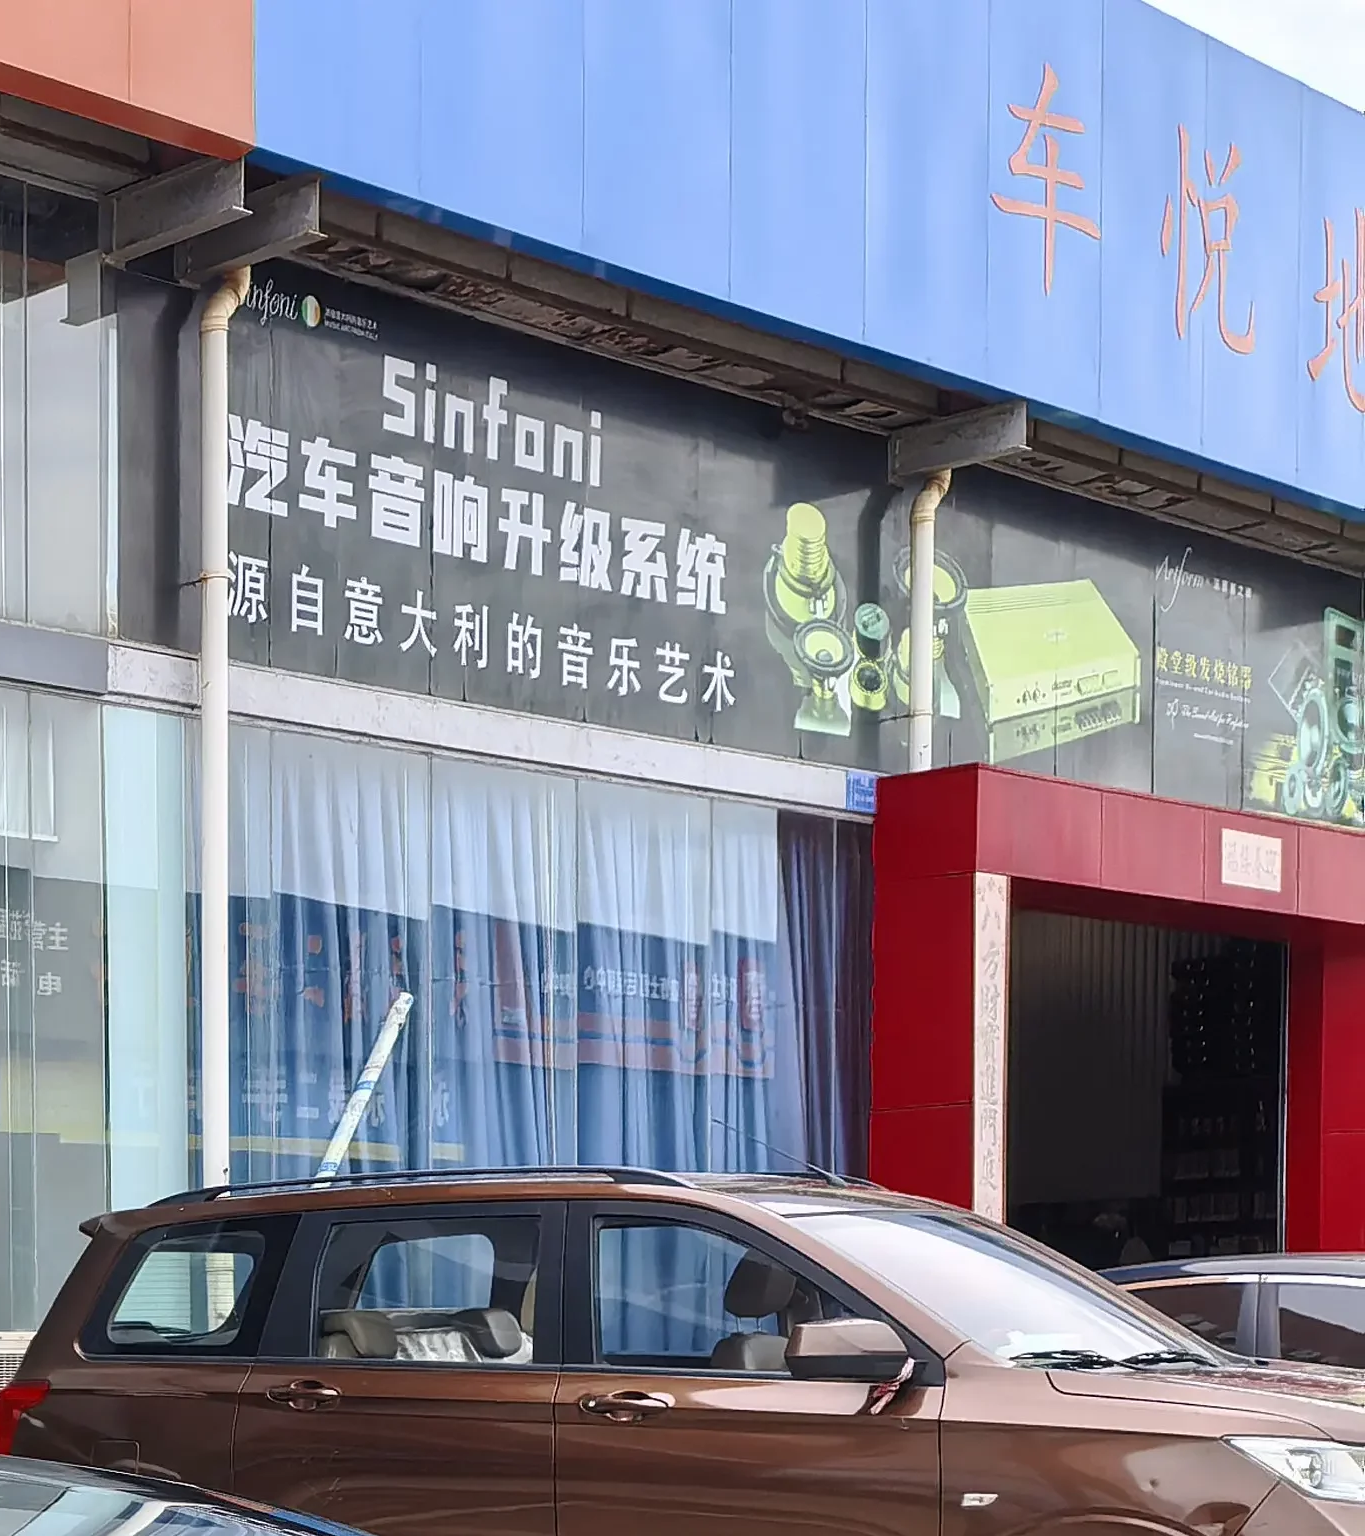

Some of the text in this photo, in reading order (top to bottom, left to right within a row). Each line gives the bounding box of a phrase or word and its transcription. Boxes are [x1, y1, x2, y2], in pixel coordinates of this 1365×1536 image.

[382, 354, 602, 487] Sinfoni
[227, 413, 727, 614] 汽车音响升级系统
[227, 551, 736, 713] 源自意大利的音乐艺术
